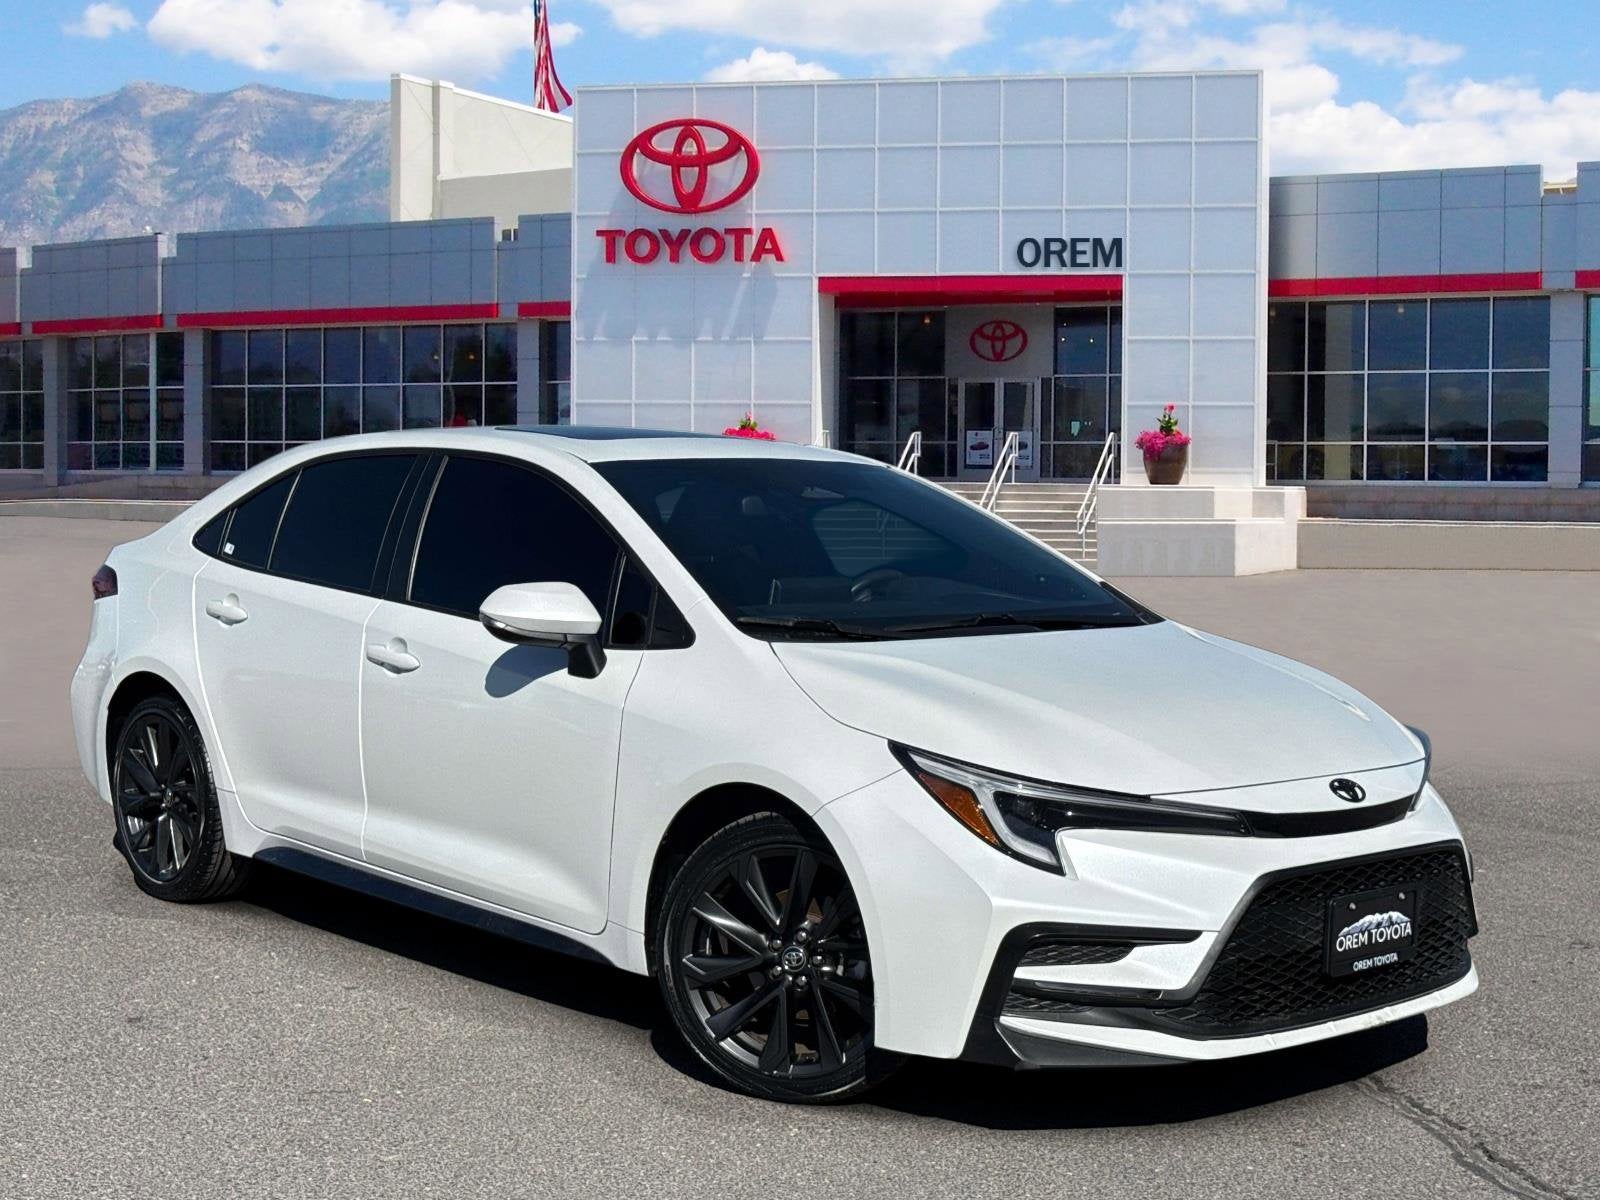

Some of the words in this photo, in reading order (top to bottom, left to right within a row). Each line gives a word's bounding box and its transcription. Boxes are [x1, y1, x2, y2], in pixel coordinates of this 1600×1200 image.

[596, 227, 785, 263] TOYOTA
[1016, 237, 1123, 268] OREM
[1336, 932, 1368, 952] OREM
[1370, 922, 1412, 944] TOYOTA
[1353, 959, 1373, 972] OREM
[1374, 952, 1398, 966] TOYOTA
